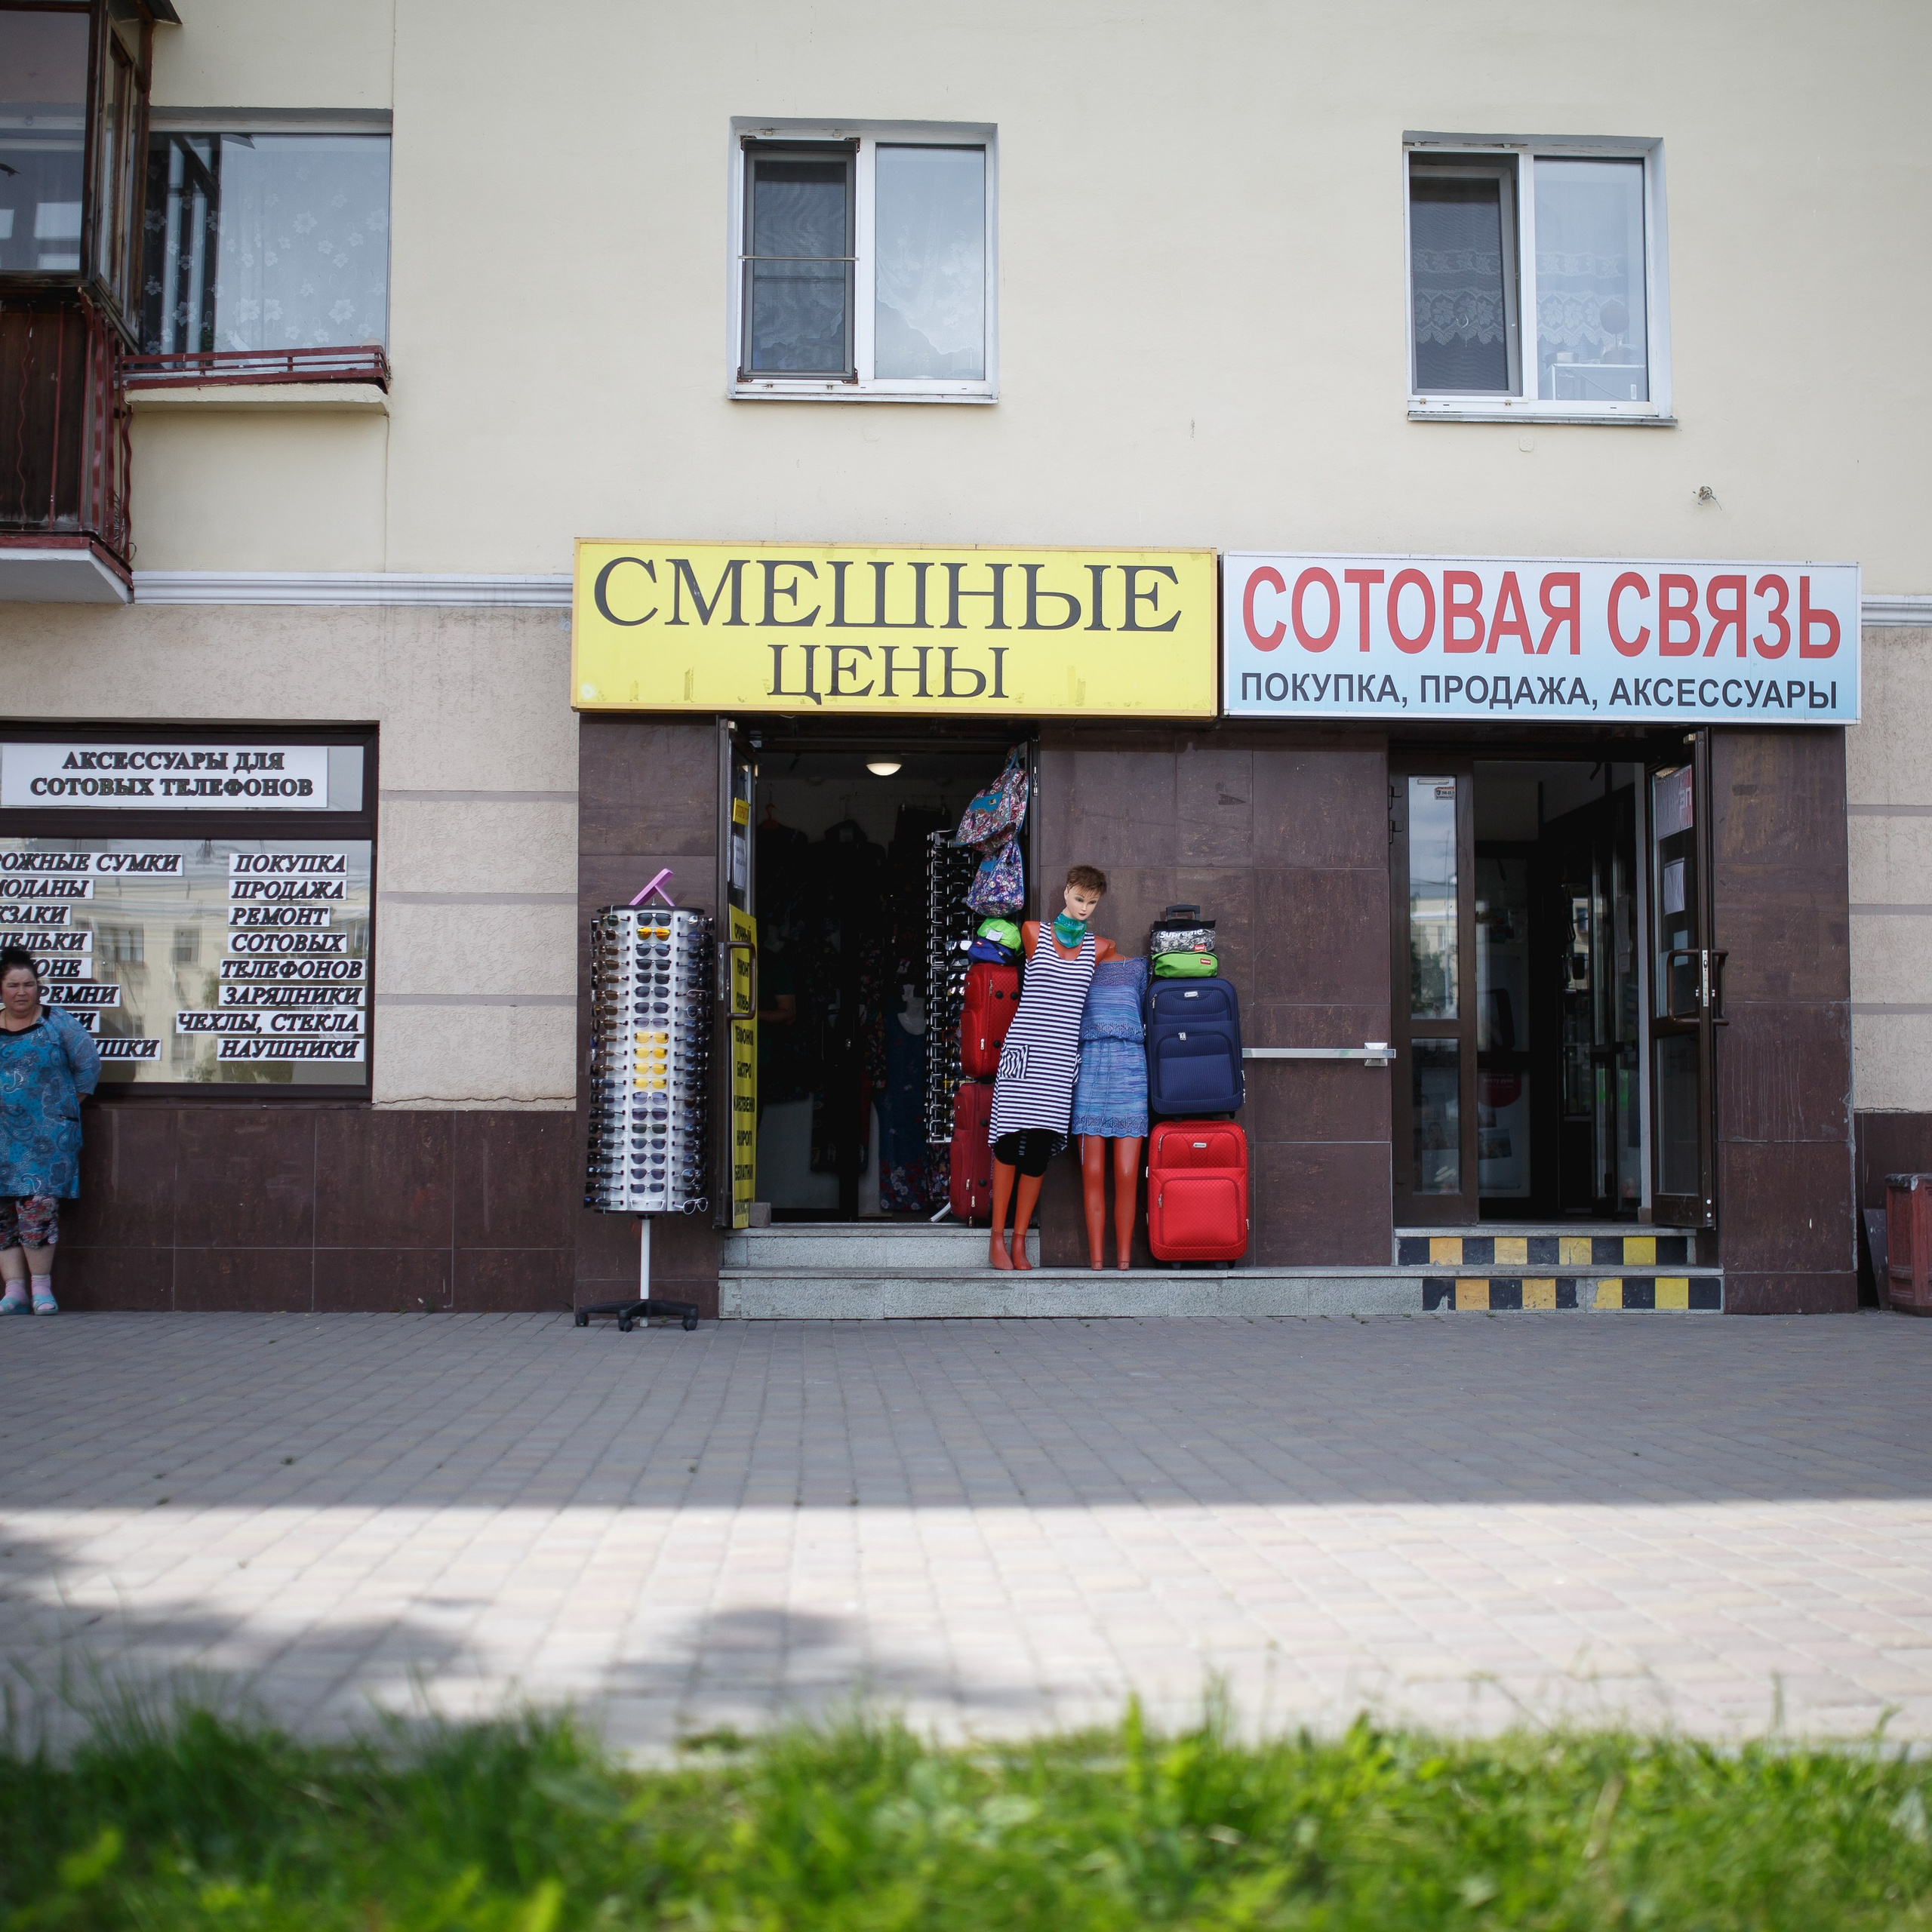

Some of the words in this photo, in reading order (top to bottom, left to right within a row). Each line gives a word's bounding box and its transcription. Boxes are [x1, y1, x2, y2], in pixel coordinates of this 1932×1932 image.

[594, 556, 1182, 632] СМЕШНЫЕ
[1242, 566, 1580, 655] СОТОВАЯ
[1607, 571, 1841, 660] СВЯЗЬ
[767, 644, 1010, 705] ЦЕНЫ
[1241, 672, 1407, 707] ПОКУПКА,
[1420, 674, 1598, 710] ПРОДАЖА,
[1609, 676, 1838, 710] АКСЕССУАРЫ
[62, 752, 227, 771] АКСЕССУАРЫ
[233, 752, 285, 774] ДЛЯ
[30, 777, 153, 796] СОТОВЫХ
[160, 778, 313, 797] ТЕЛЕФОНОВ
[0, 852, 91, 872] ОЖНЫЕ
[97, 853, 181, 872] СУМКИ
[233, 854, 346, 873] ПОКУПКА
[231, 881, 343, 900] ПРОДАЖА
[229, 907, 328, 926] РЕМОНТ
[231, 934, 346, 952] СОТОВЫХ
[1159, 929, 1203, 939] Supreme
[32, 958, 82, 977] ОНЕ
[222, 960, 362, 979] ТЕЛЕФОНОВ
[223, 986, 362, 1007] ЗАРЯДНИКИ
[178, 1014, 263, 1033] ЧЕХЛЫ,
[271, 1014, 359, 1032] СТЕКЛА
[218, 1040, 359, 1058] НАУШНИКИ
